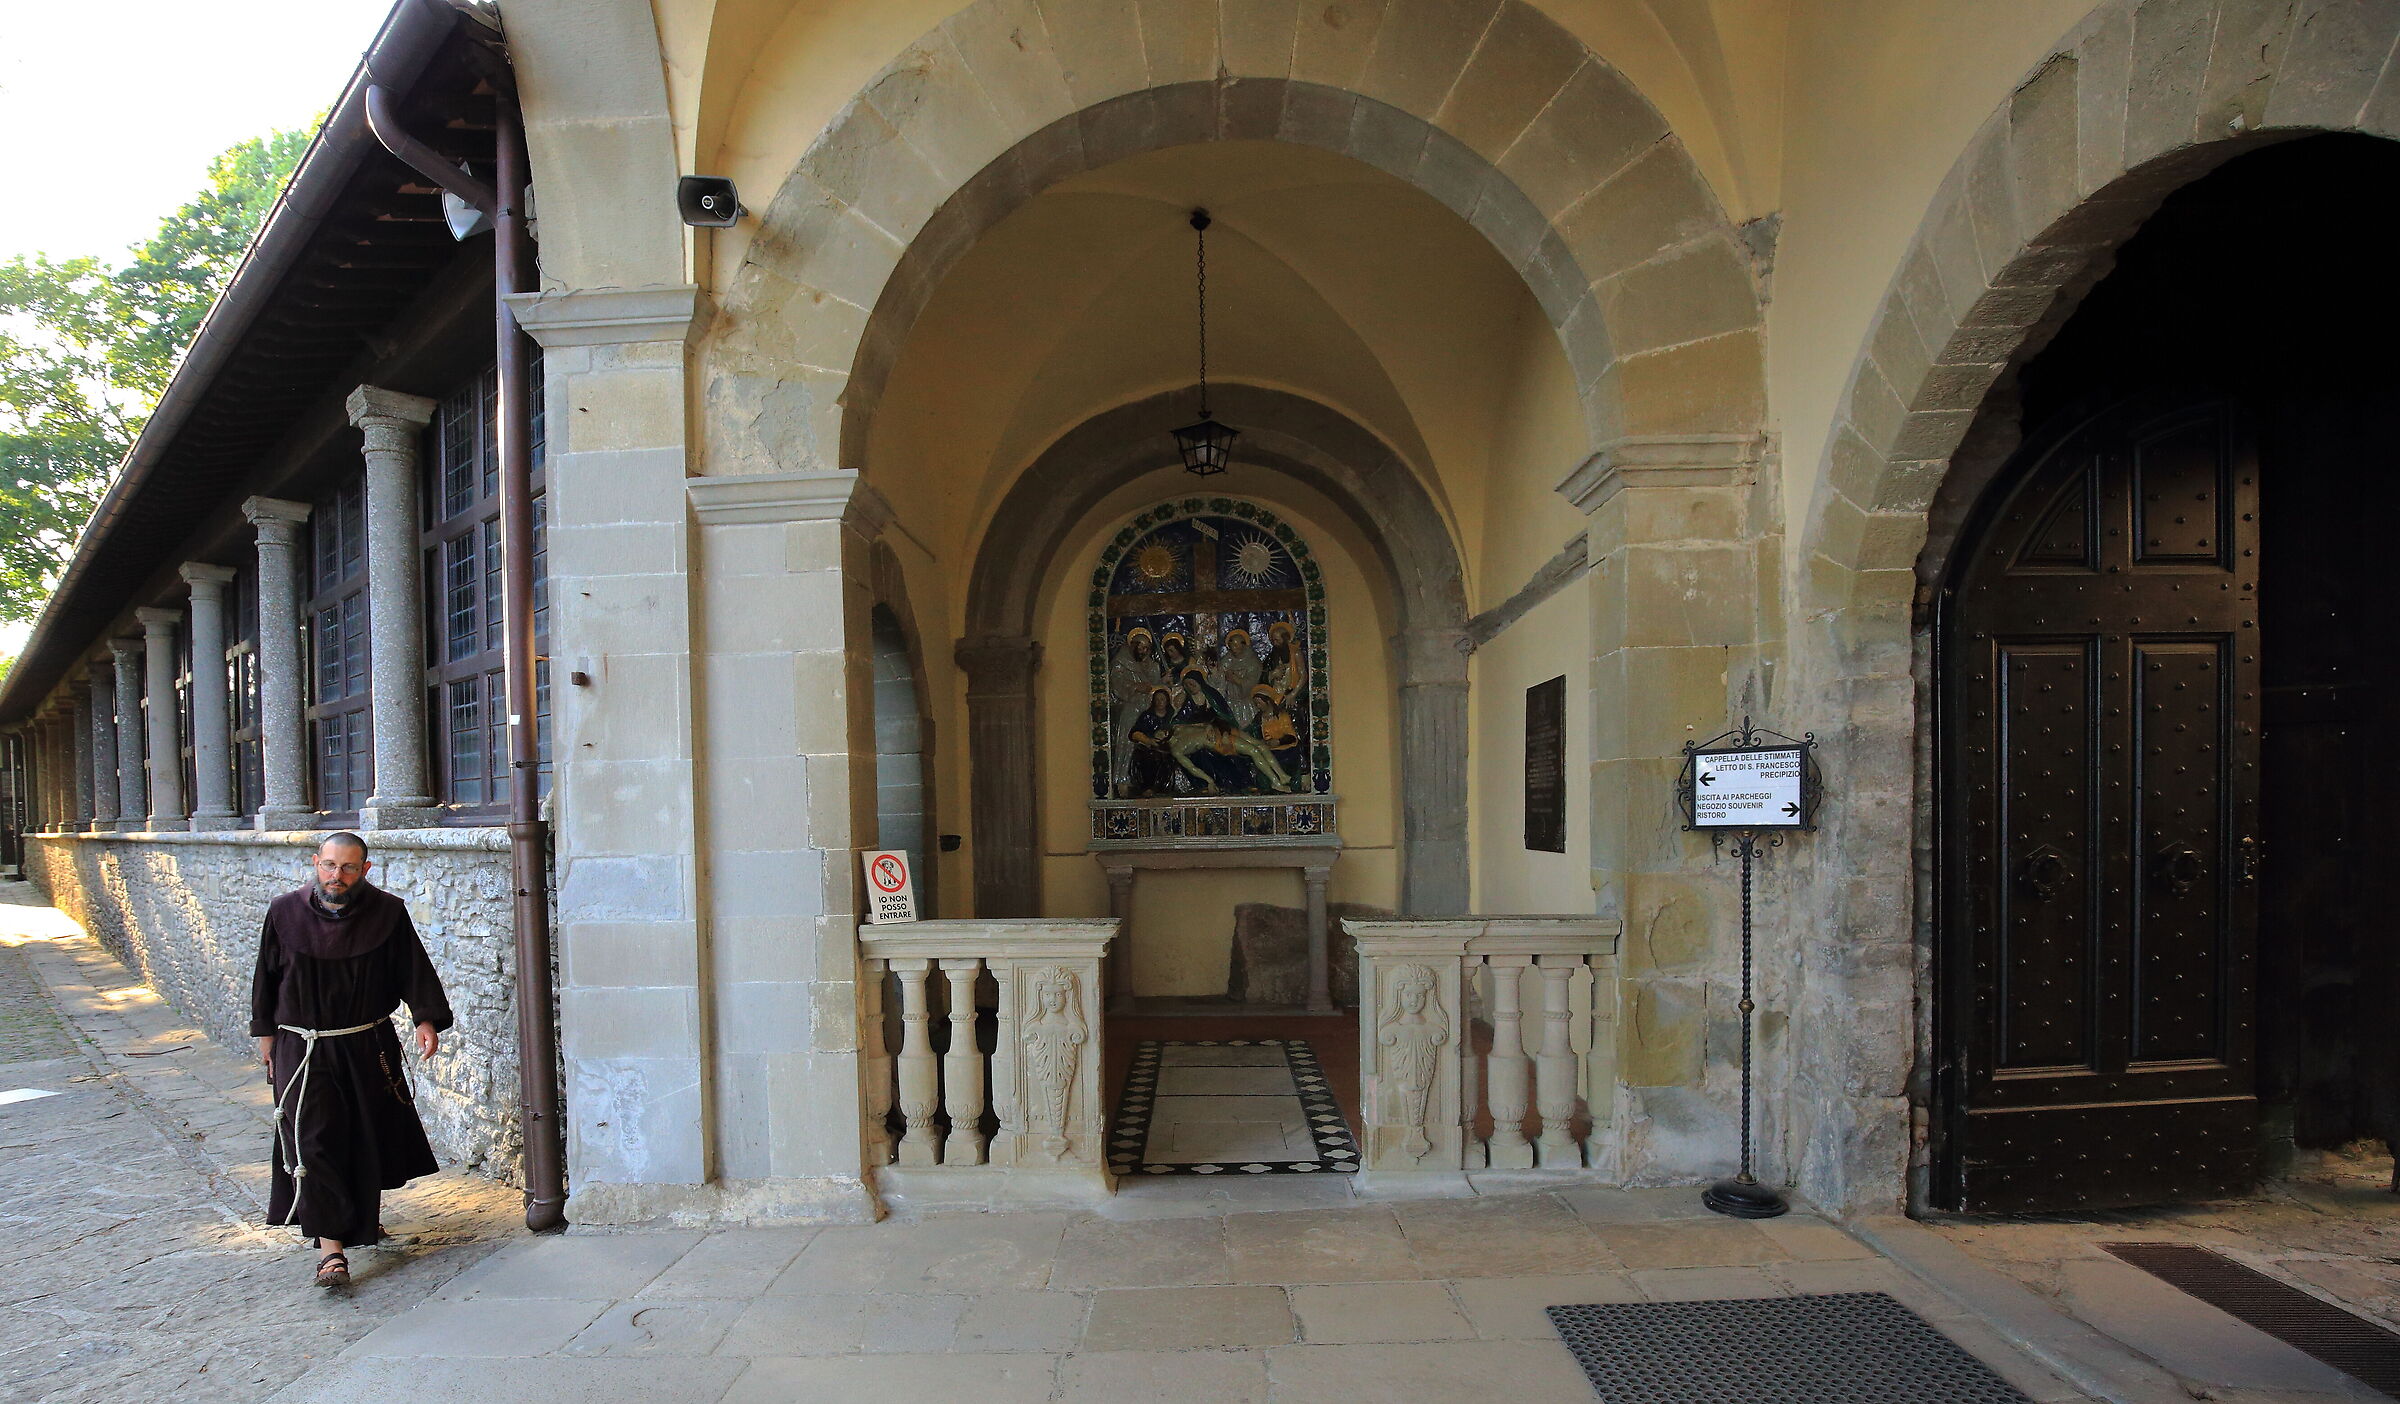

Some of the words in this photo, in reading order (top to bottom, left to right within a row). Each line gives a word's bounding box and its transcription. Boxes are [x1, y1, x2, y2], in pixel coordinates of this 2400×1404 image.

[1705, 755, 1739, 763] CAPPELLA
[1740, 753, 1762, 761] DELLE
[1764, 752, 1800, 760] STIMMATE
[1715, 763, 1737, 772] LETTO
[1739, 763, 1746, 771] DI
[1747, 762, 1754, 770] S.
[1756, 761, 1800, 770] FRANCESCO
[1760, 770, 1800, 778] PRECIPIZIO
[1731, 792, 1772, 800] PARCHEGGI
[1697, 802, 1727, 810] NEGOZIO
[1697, 811, 1727, 819] RISTORO
[889, 895, 908, 903] NON
[881, 903, 907, 911] POSSO
[879, 911, 911, 919] ENTRARE
